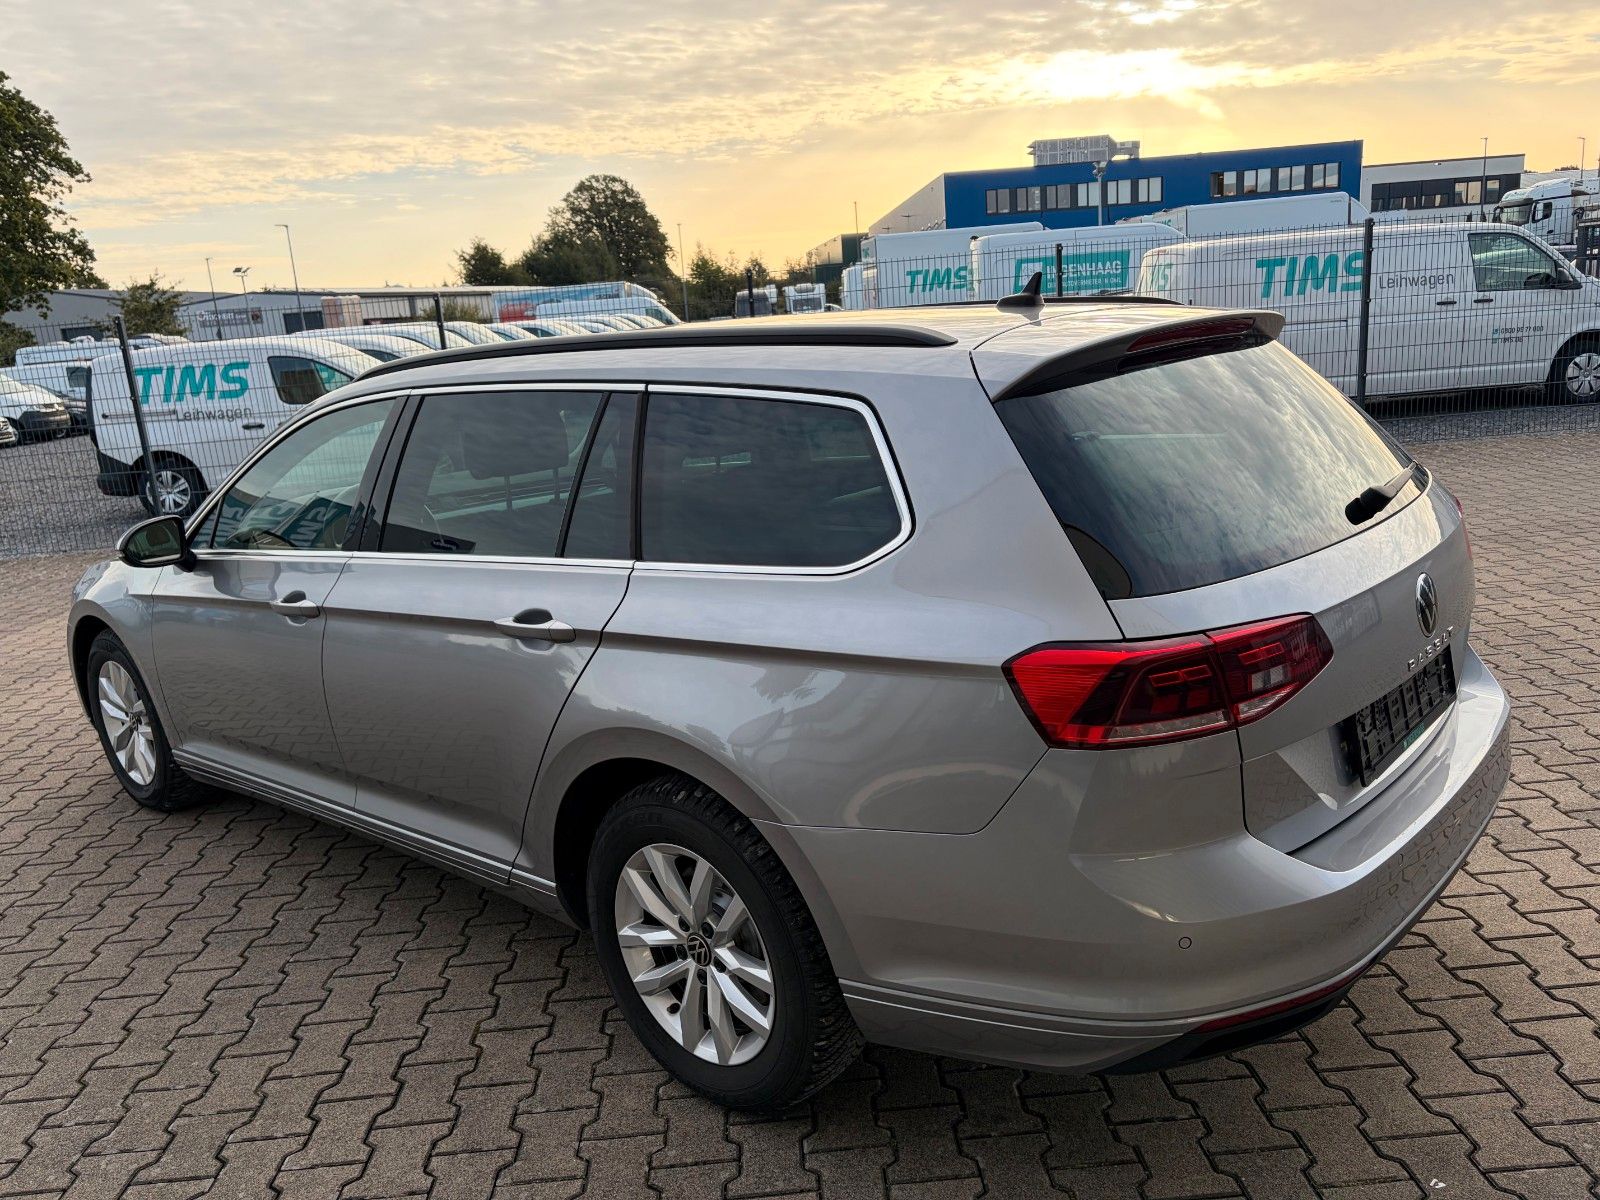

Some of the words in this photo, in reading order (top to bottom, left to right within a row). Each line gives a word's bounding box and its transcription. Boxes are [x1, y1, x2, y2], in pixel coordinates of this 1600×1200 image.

[906, 266, 968, 294] TIMS
[1256, 252, 1364, 298] TIMS
[1379, 274, 1455, 289] Leihwagen
[134, 361, 250, 404] TIMS
[176, 407, 252, 422] Leihwagen
[1407, 626, 1453, 671] PASSAT
